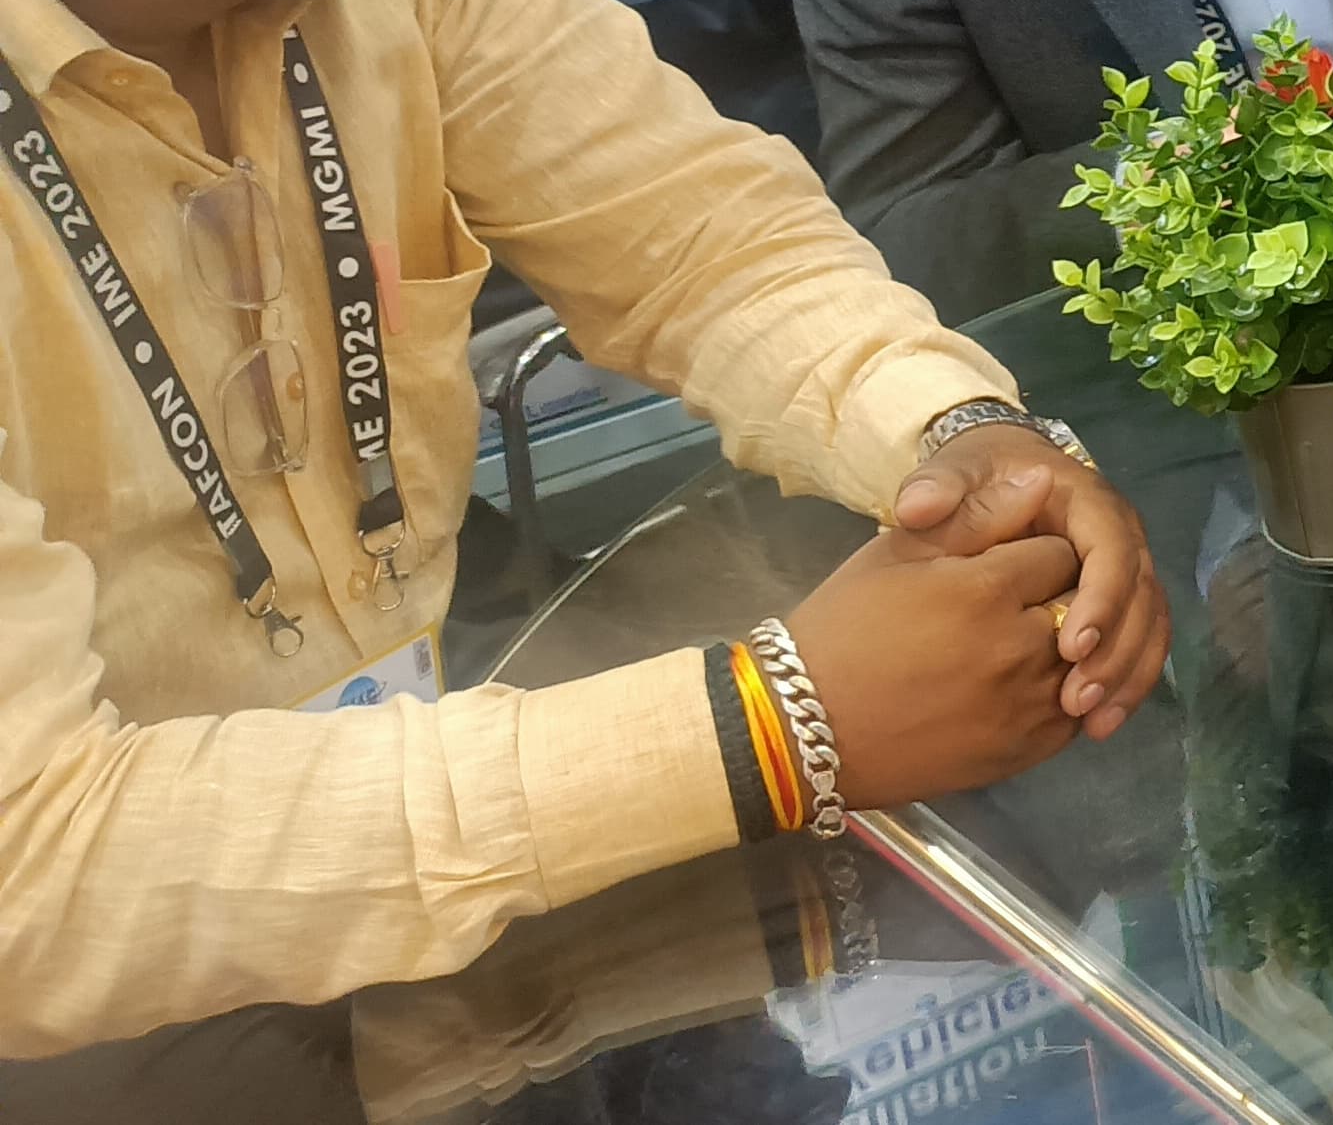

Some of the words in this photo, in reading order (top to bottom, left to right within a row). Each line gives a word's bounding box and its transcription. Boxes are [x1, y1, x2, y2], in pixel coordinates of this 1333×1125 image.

[12, 129, 91, 239] 2023
[301, 106, 356, 232] MGMI
[82, 241, 138, 328] IME
[338, 300, 390, 404] 2023
[151, 375, 244, 540] TAFCON
